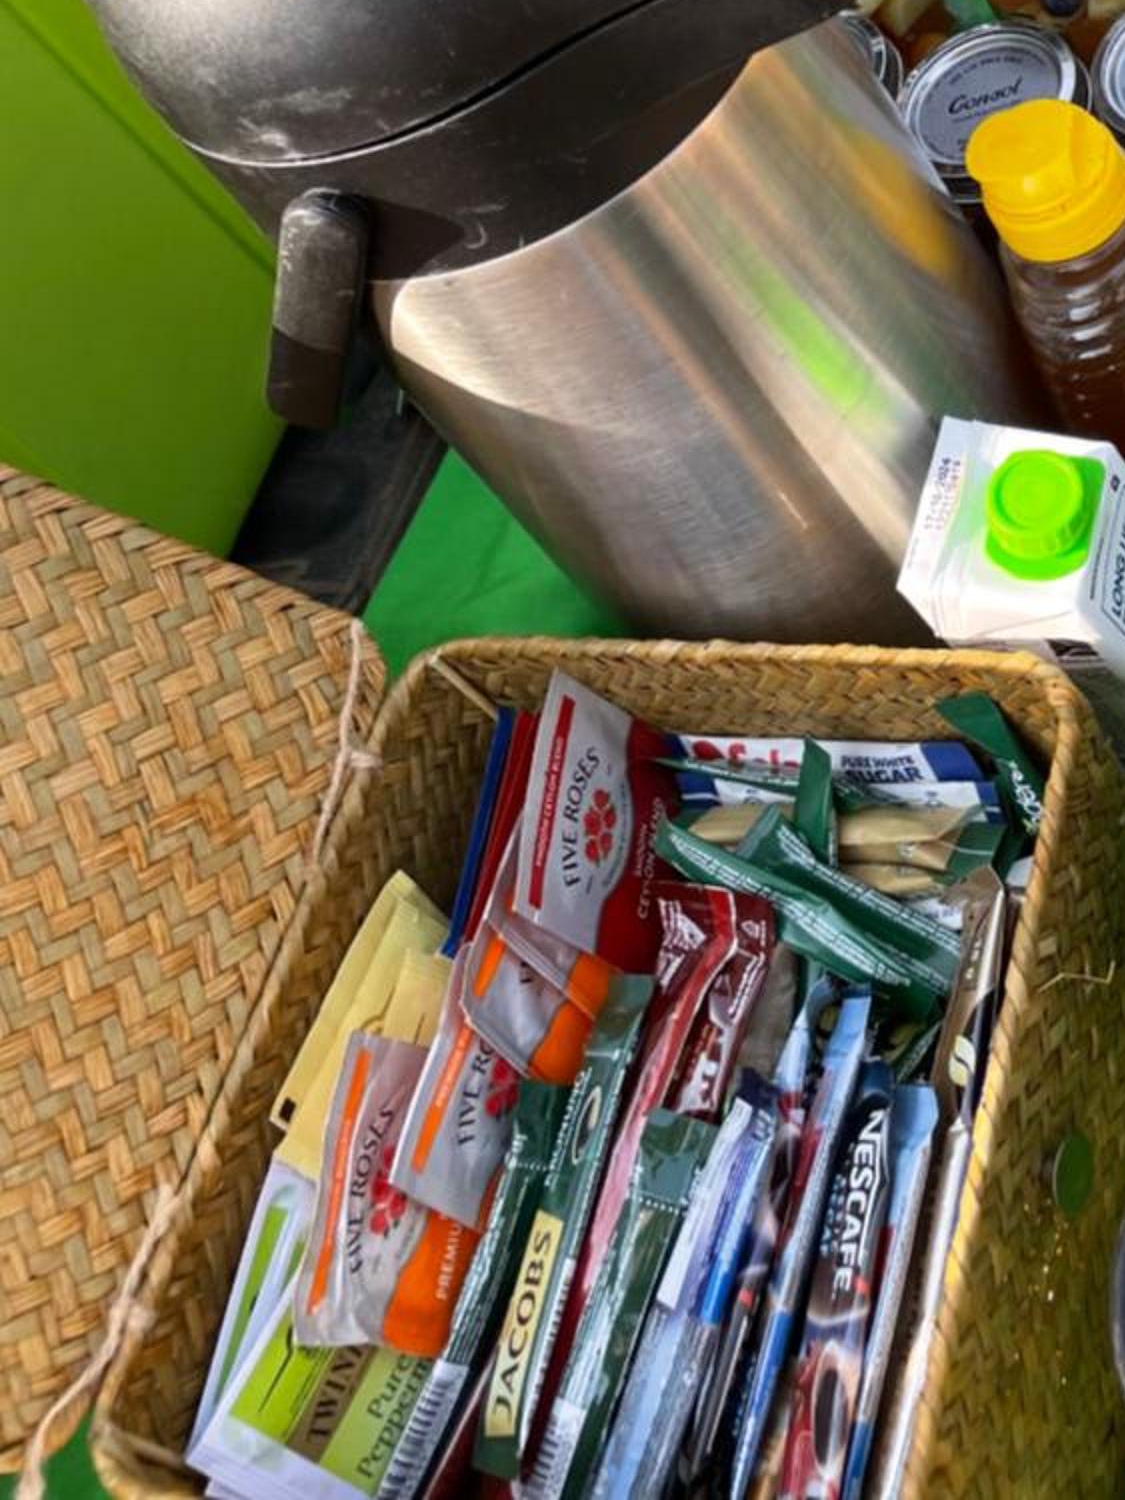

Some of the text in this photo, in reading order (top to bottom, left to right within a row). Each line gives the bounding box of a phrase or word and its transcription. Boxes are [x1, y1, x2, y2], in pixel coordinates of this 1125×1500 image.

[947, 76, 1023, 115] Consol
[872, 754, 915, 768] WHITE
[561, 746, 601, 888] FIVE ROSES
[457, 1083, 481, 1146] FIVE
[351, 1105, 396, 1198] ROSES
[491, 1229, 552, 1422] JACOBS
[367, 1353, 411, 1419] Pure
